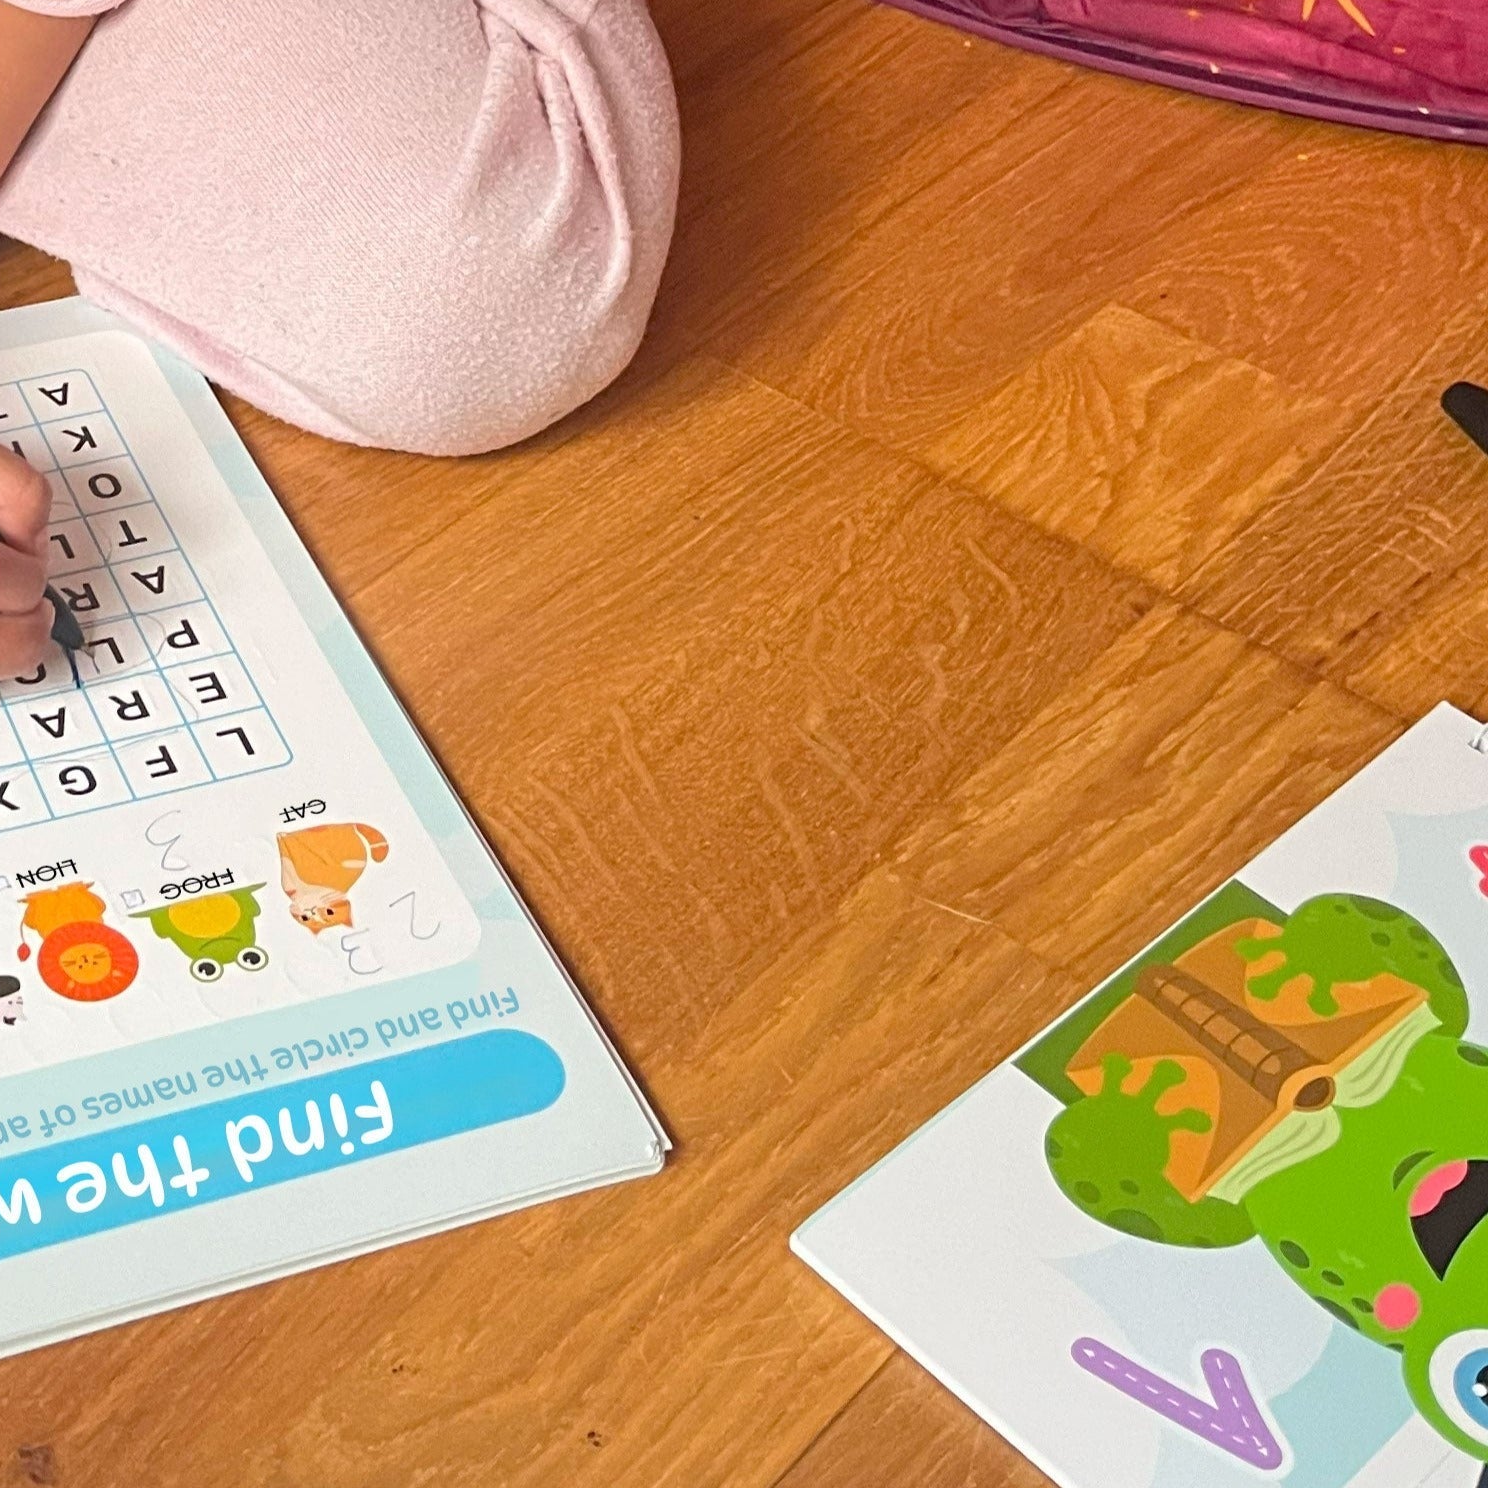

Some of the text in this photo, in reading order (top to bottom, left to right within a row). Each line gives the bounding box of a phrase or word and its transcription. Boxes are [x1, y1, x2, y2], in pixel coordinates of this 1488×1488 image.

[37, 381, 70, 407] A
[61, 425, 98, 454] K
[87, 472, 123, 500] O
[117, 518, 149, 549] T
[129, 564, 166, 596] A
[165, 618, 201, 650] P
[187, 670, 228, 705] E
[107, 689, 151, 722] R
[29, 706, 67, 740] A
[215, 726, 256, 757] L
[144, 744, 179, 779] F
[57, 764, 98, 797] G
[279, 797, 328, 825] CAT
[15, 858, 80, 890] LION
[159, 866, 236, 901] FROG
[375, 1005, 444, 1043] and
[449, 985, 522, 1031] Find
[275, 1025, 370, 1069] circle
[210, 1053, 270, 1092] the
[83, 1072, 200, 1118] names
[40, 1107, 78, 1137] of
[226, 1080, 396, 1184] Find
[57, 1134, 212, 1216] the
